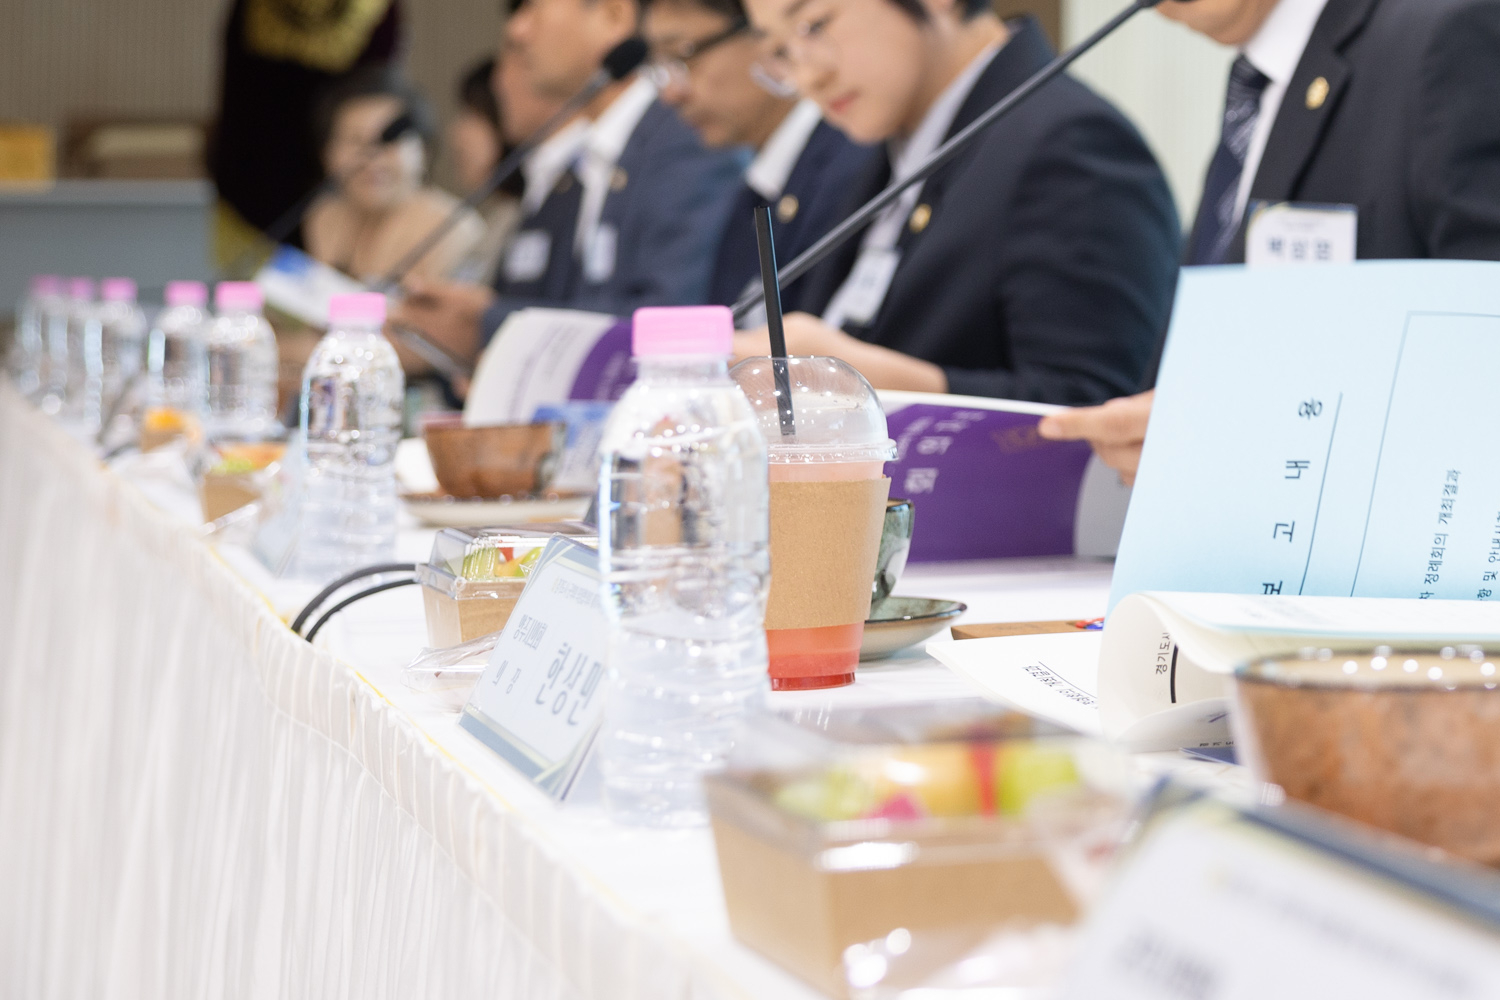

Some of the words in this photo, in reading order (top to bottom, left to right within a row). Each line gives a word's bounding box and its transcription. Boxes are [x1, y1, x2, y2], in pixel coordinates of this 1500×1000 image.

[1424, 532, 1449, 585] 정례회의
[1438, 468, 1462, 525] 개최결과
[1482, 570, 1499, 582] 및
